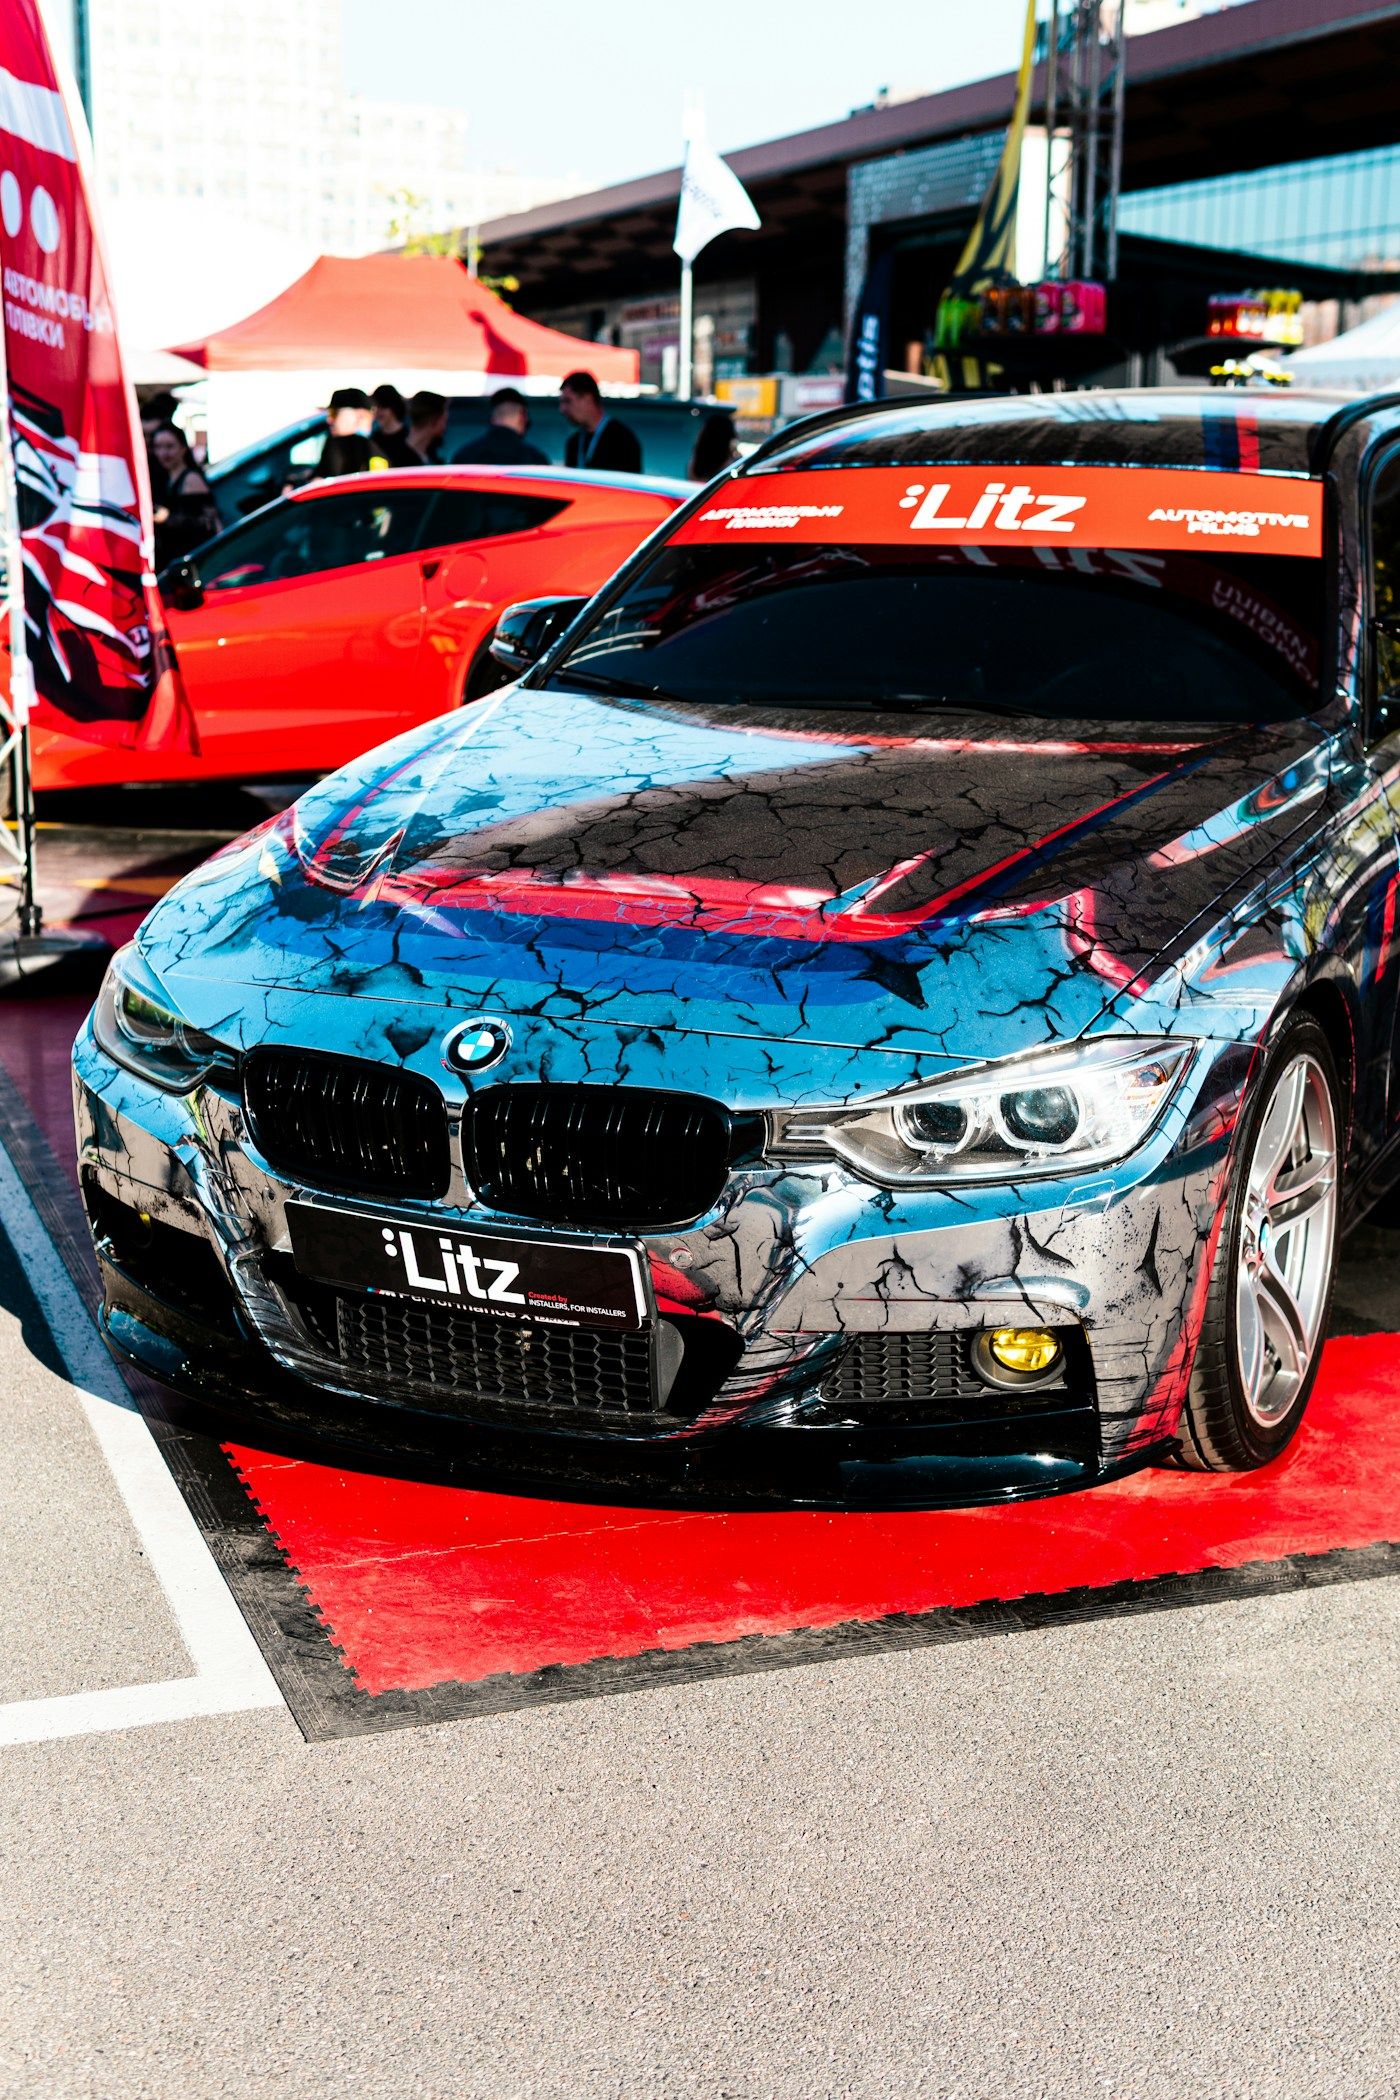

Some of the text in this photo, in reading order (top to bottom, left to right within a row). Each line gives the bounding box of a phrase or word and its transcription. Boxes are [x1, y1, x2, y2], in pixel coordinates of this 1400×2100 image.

[1148, 508, 1309, 528] AUTOMOTIVE
[1187, 521, 1260, 536] FILMS
[461, 1023, 505, 1040] BMW
[528, 1291, 568, 1304] Created by
[529, 1298, 627, 1318] INSTALLERS, FOR INSTALLERS
